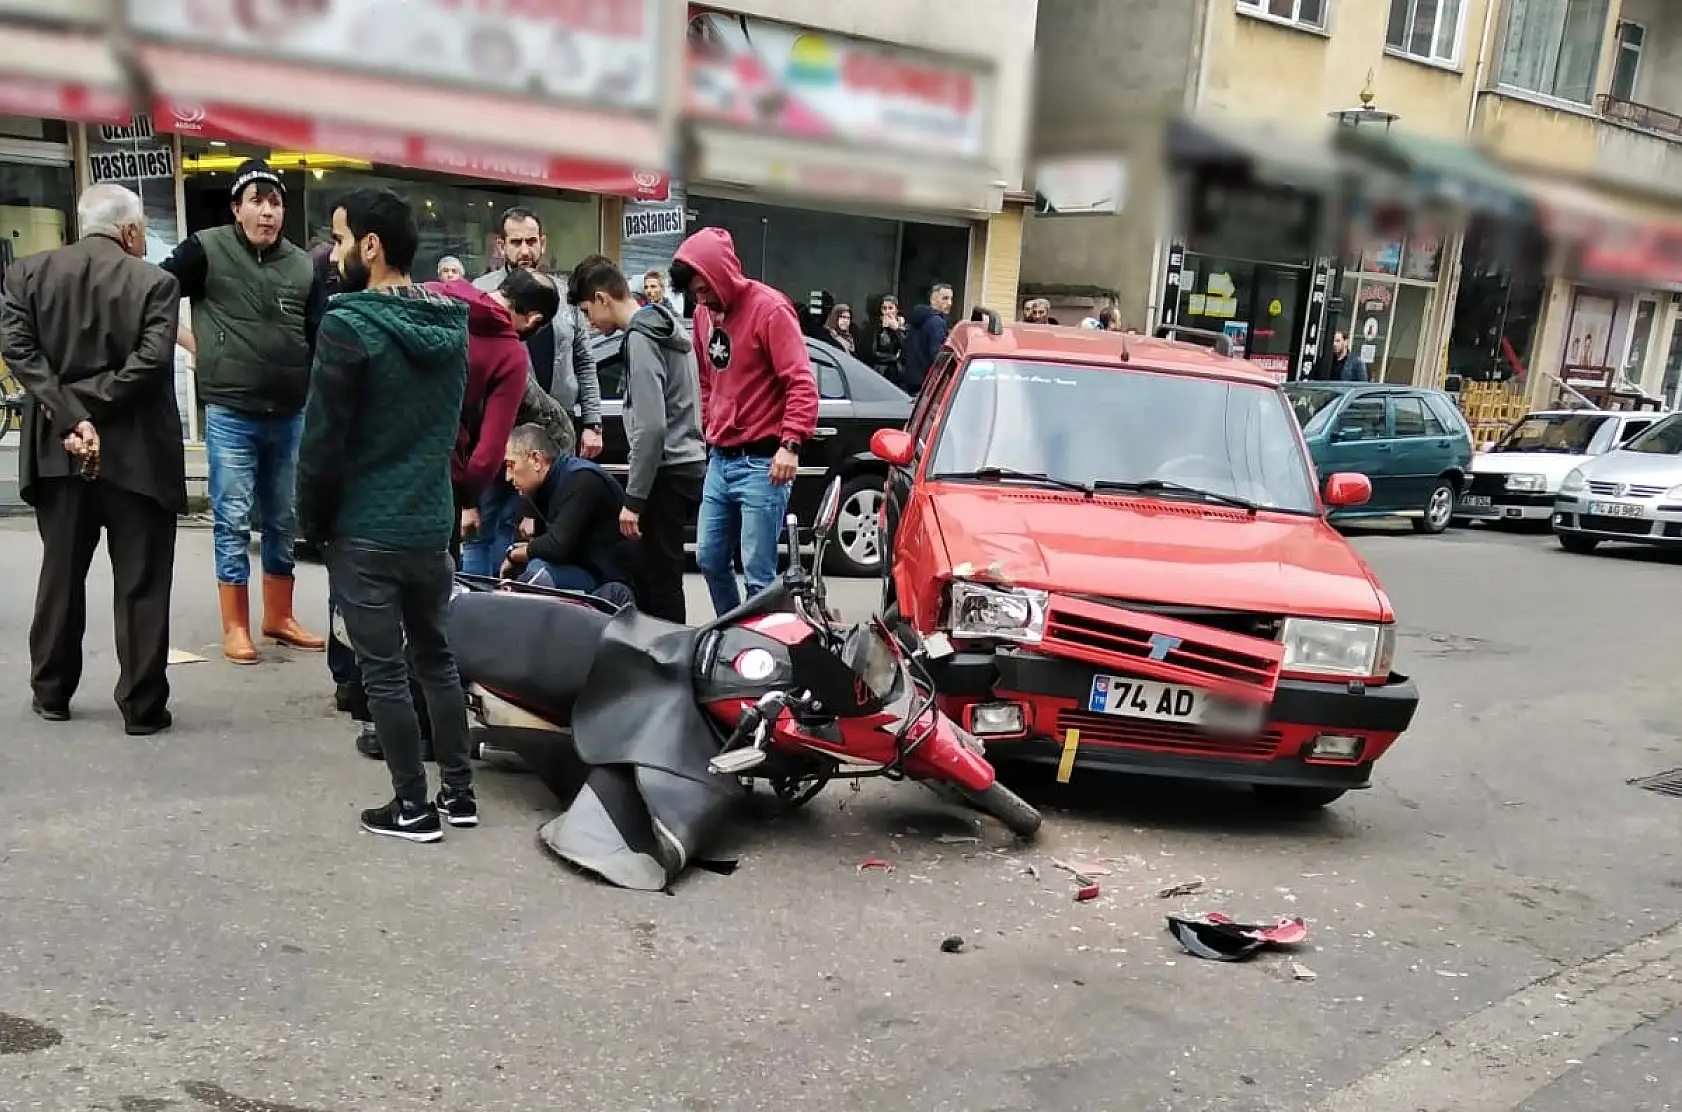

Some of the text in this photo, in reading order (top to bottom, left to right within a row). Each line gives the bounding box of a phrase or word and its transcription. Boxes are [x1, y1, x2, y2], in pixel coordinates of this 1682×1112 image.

[90, 146, 173, 182] pastanesi
[625, 206, 683, 238] pastanesi
[1113, 681, 1148, 712] 74
[1155, 686, 1195, 717] AD
